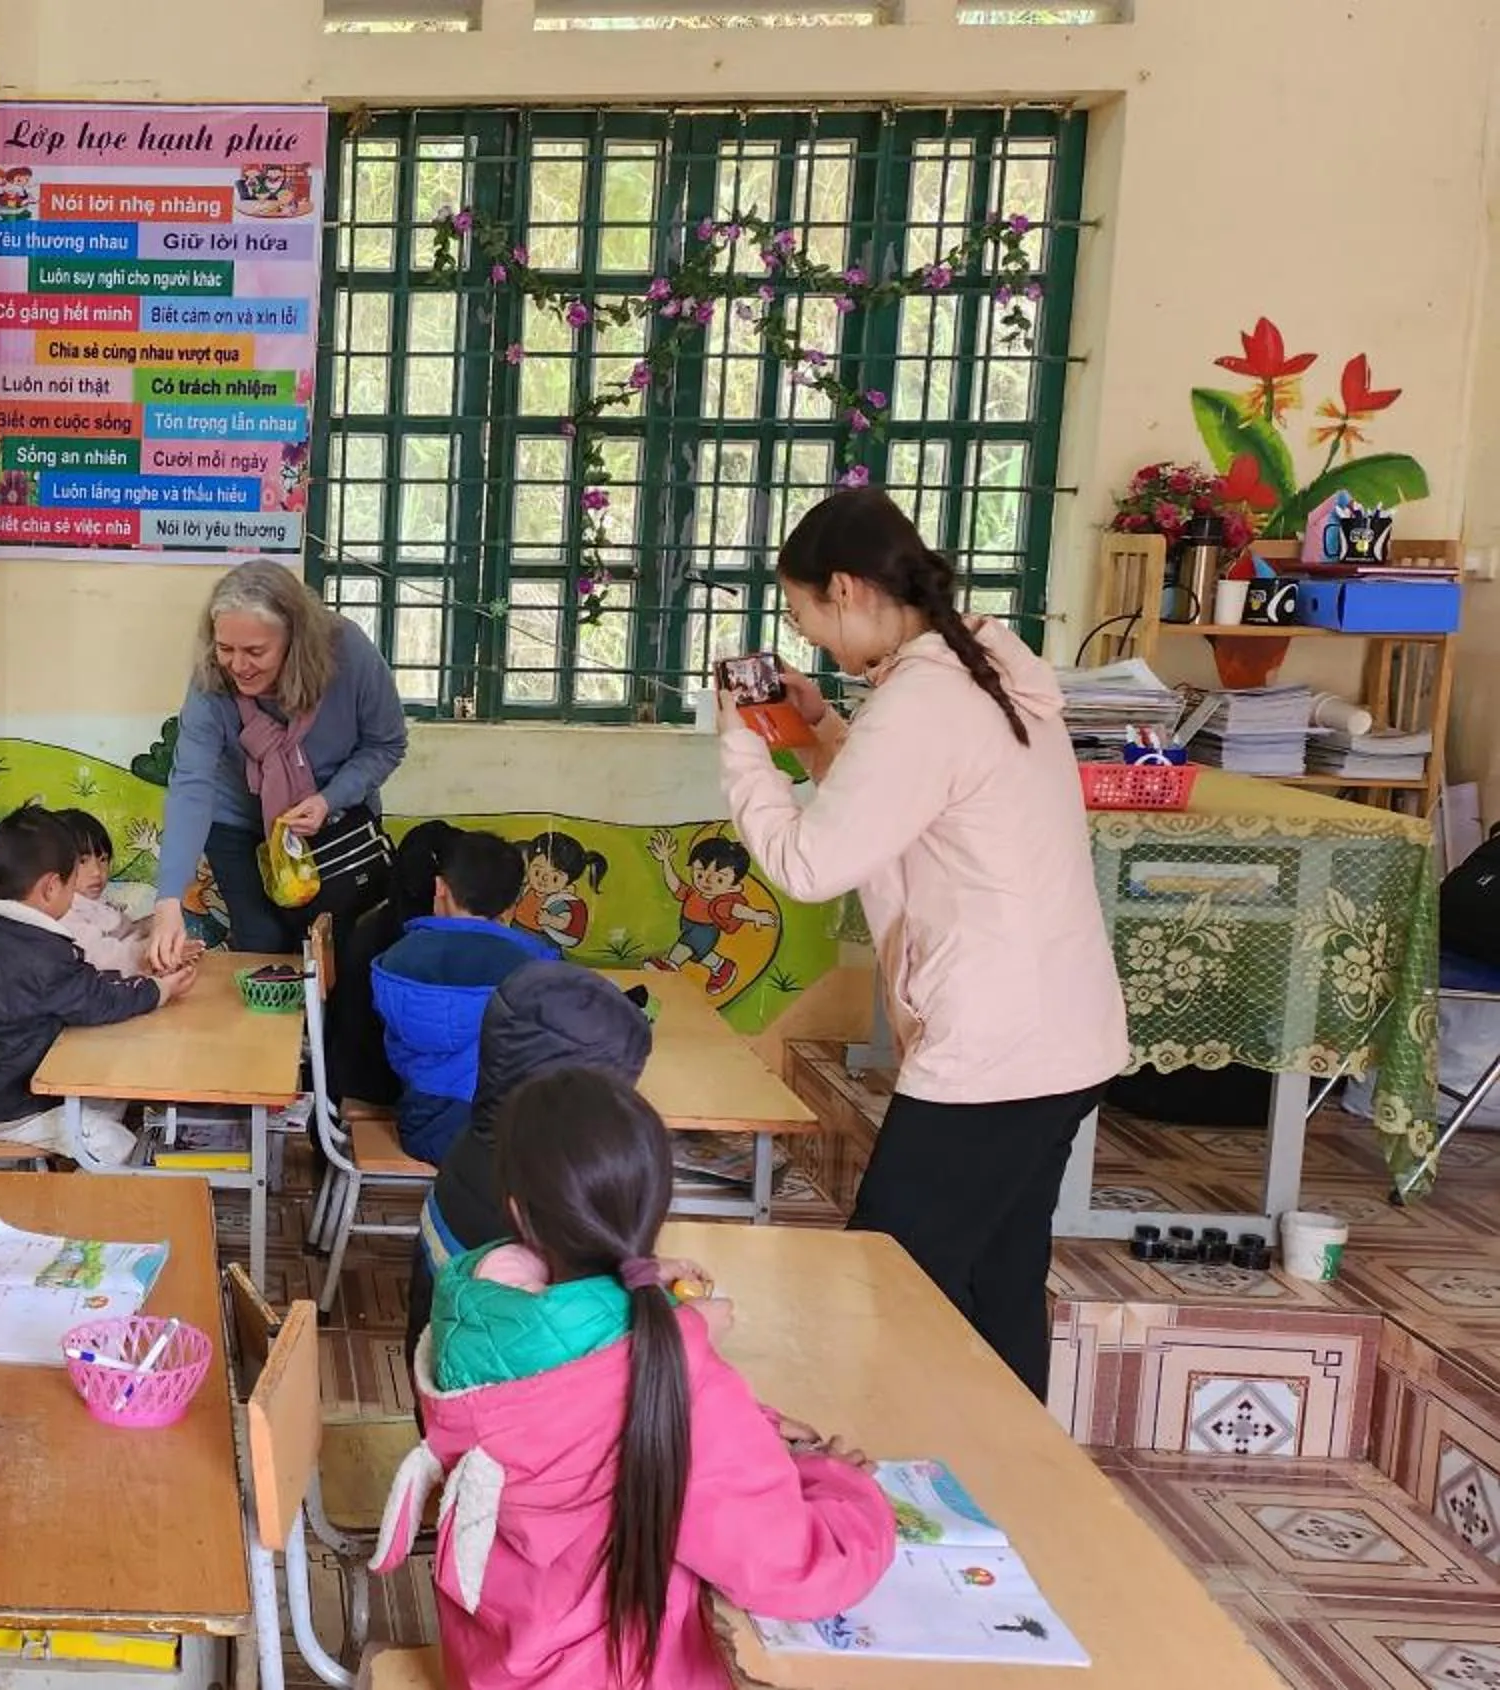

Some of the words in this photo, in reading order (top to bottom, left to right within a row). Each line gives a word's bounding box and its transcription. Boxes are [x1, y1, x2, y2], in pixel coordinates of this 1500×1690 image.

[5, 119, 66, 155] Lớp
[76, 122, 128, 156] học
[137, 122, 214, 157] hạnh
[226, 123, 299, 157] phúc
[51, 194, 83, 212] Nói
[89, 194, 115, 212] lời
[120, 196, 155, 217] nhẹ
[161, 199, 222, 217] nhàng
[25, 233, 85, 253] thương
[89, 234, 129, 250] nhau
[163, 233, 205, 250] Giữ
[210, 233, 238, 251] lời
[246, 233, 288, 251] hứa
[39, 267, 71, 284] Luôn
[73, 271, 95, 289] suy
[98, 269, 125, 289] nghĩ
[127, 270, 150, 285] cho
[153, 271, 190, 290] người
[193, 270, 222, 287] khác
[20, 299, 59, 324] gắng
[63, 301, 89, 321] hết
[151, 304, 179, 323] Biết
[213, 310, 233, 324] ơn
[237, 308, 253, 325] và
[257, 308, 277, 325] xin
[281, 305, 297, 325] lỗi
[49, 341, 79, 358] Chia
[83, 341, 99, 358] sẻ
[139, 344, 174, 361] nhau
[177, 345, 211, 365] vượt
[213, 348, 240, 365] qua
[2, 376, 43, 393] Luôn
[49, 376, 73, 393] nói
[78, 377, 110, 398] thật
[151, 377, 175, 395] Có
[179, 378, 221, 395] trách
[226, 379, 277, 399] nhiệm
[29, 414, 49, 429] ơn
[54, 413, 90, 433] cuộc
[94, 410, 132, 434] sống
[154, 412, 183, 430] Tôn
[187, 415, 228, 435] trọng
[231, 411, 255, 431] lẫn
[259, 415, 297, 432] nhau
[17, 444, 57, 467] Sống
[61, 452, 79, 464] an
[84, 449, 127, 465] nhiên
[153, 450, 193, 467] Cười
[197, 450, 225, 467] mỗi
[231, 452, 268, 473] ngày
[53, 482, 87, 499] Luôn
[91, 480, 122, 504] lắng
[124, 485, 159, 505] nghe
[163, 485, 179, 501] và
[217, 483, 247, 503] hiểu
[22, 516, 51, 533] chia
[54, 517, 71, 533] sẻ
[73, 518, 102, 538] việc
[156, 519, 179, 535] Nói
[183, 519, 201, 536] lời
[205, 520, 232, 540] yêu
[235, 522, 286, 541] thương
